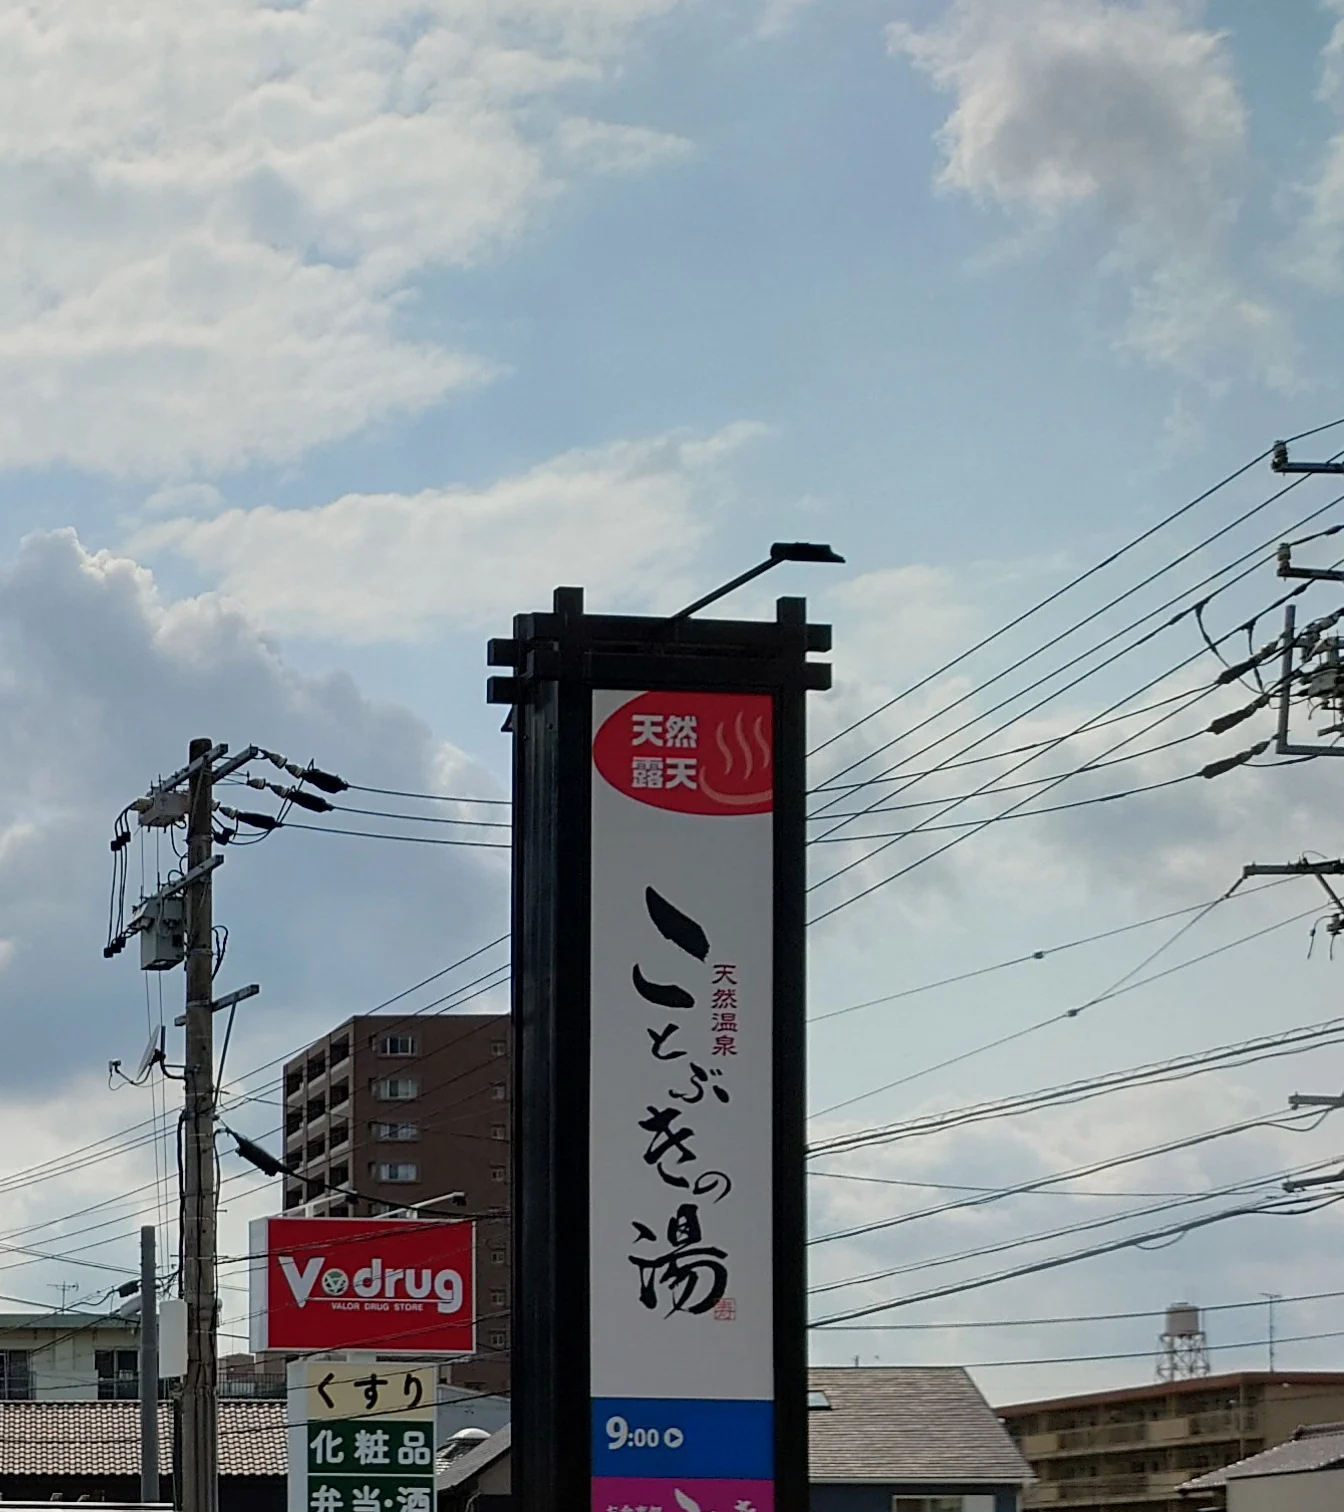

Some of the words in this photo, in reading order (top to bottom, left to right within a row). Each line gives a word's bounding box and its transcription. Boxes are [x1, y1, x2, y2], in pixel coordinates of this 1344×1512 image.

[631, 714, 697, 748] 天然
[631, 756, 697, 789] 露天
[711, 963, 738, 1056] 天然温泉
[628, 885, 732, 1320] ことぶきの湯
[331, 1302, 360, 1311] VALOR
[364, 1302, 390, 1311] DRUG
[394, 1302, 424, 1312] STORE
[316, 1372, 424, 1409] くすり
[309, 1429, 431, 1466] 化粧品
[606, 1415, 660, 1450] 9:00
